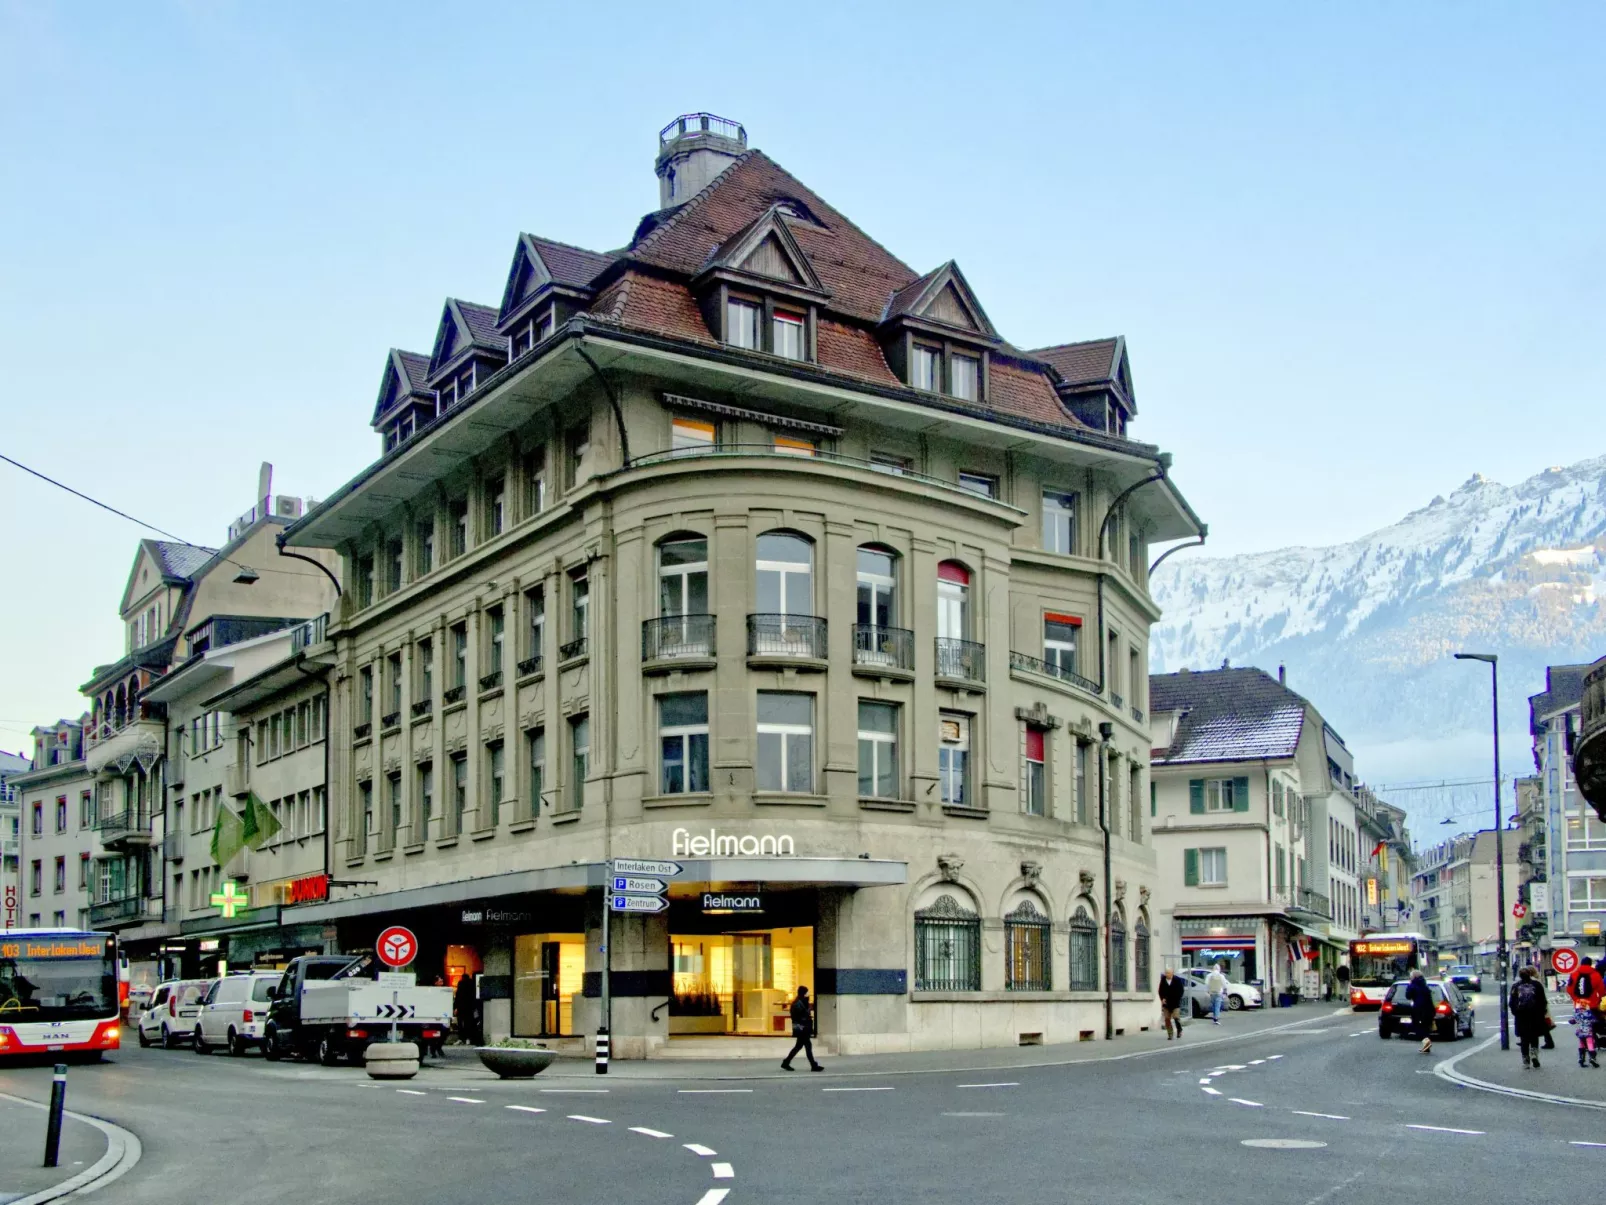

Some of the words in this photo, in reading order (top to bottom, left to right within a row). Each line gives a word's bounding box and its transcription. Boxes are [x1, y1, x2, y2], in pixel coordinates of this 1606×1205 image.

[672, 827, 794, 856] fielmann
[617, 862, 656, 872] Interlaken
[658, 864, 671, 872] Ost
[629, 880, 656, 890] Rosen
[627, 898, 657, 908] Zentrum
[703, 894, 760, 908] fielmann
[2, 943, 20, 958] 103
